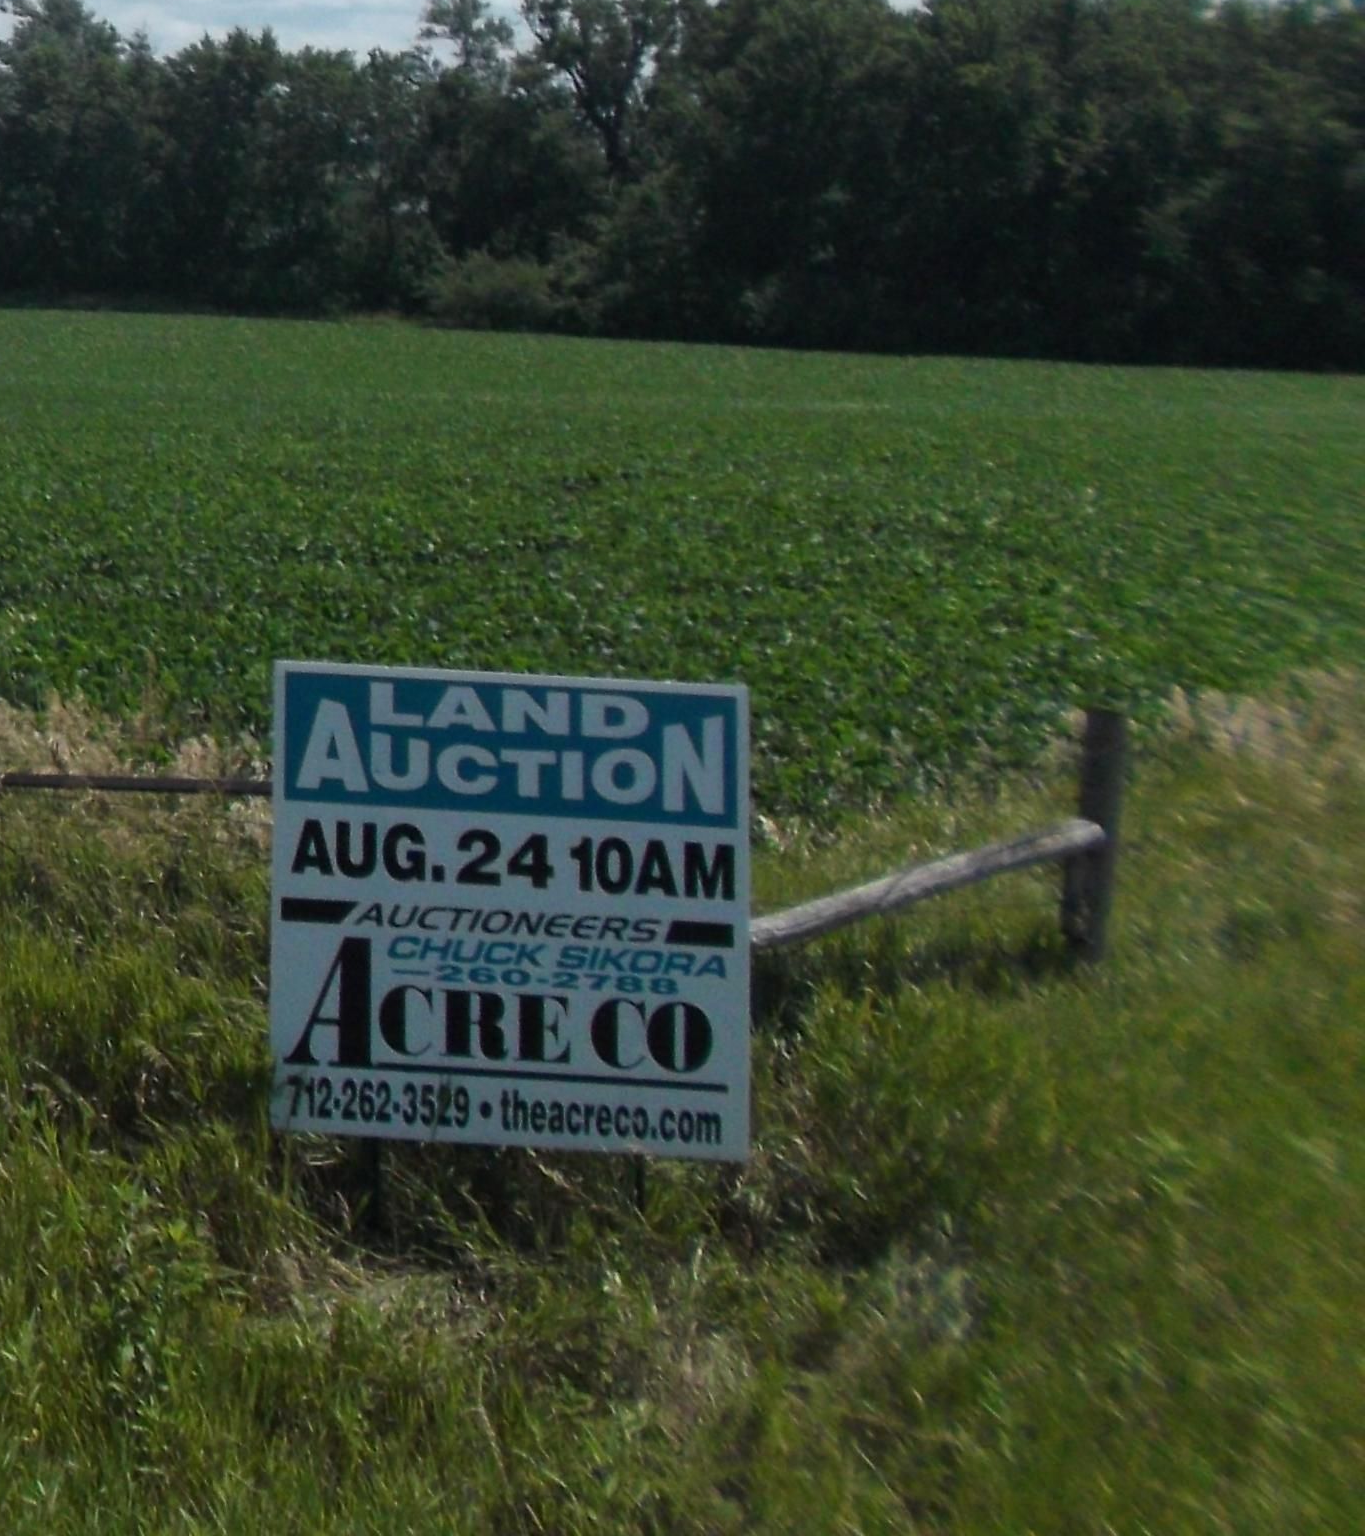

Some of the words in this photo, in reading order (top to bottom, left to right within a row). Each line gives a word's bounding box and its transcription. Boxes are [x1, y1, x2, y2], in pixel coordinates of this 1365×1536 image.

[370, 682, 649, 739] LAND
[295, 697, 725, 815] AUCTION
[290, 819, 445, 883] AUG.
[455, 829, 555, 889] 24
[569, 837, 735, 901] 10AM
[353, 902, 661, 943] AUCTIONEERS
[386, 936, 542, 967] CHUCK
[555, 947, 728, 979] SIKORA
[283, 936, 569, 1065] ACRE
[589, 998, 713, 1074] CO
[500, 1091, 722, 1145] theacreco.com
